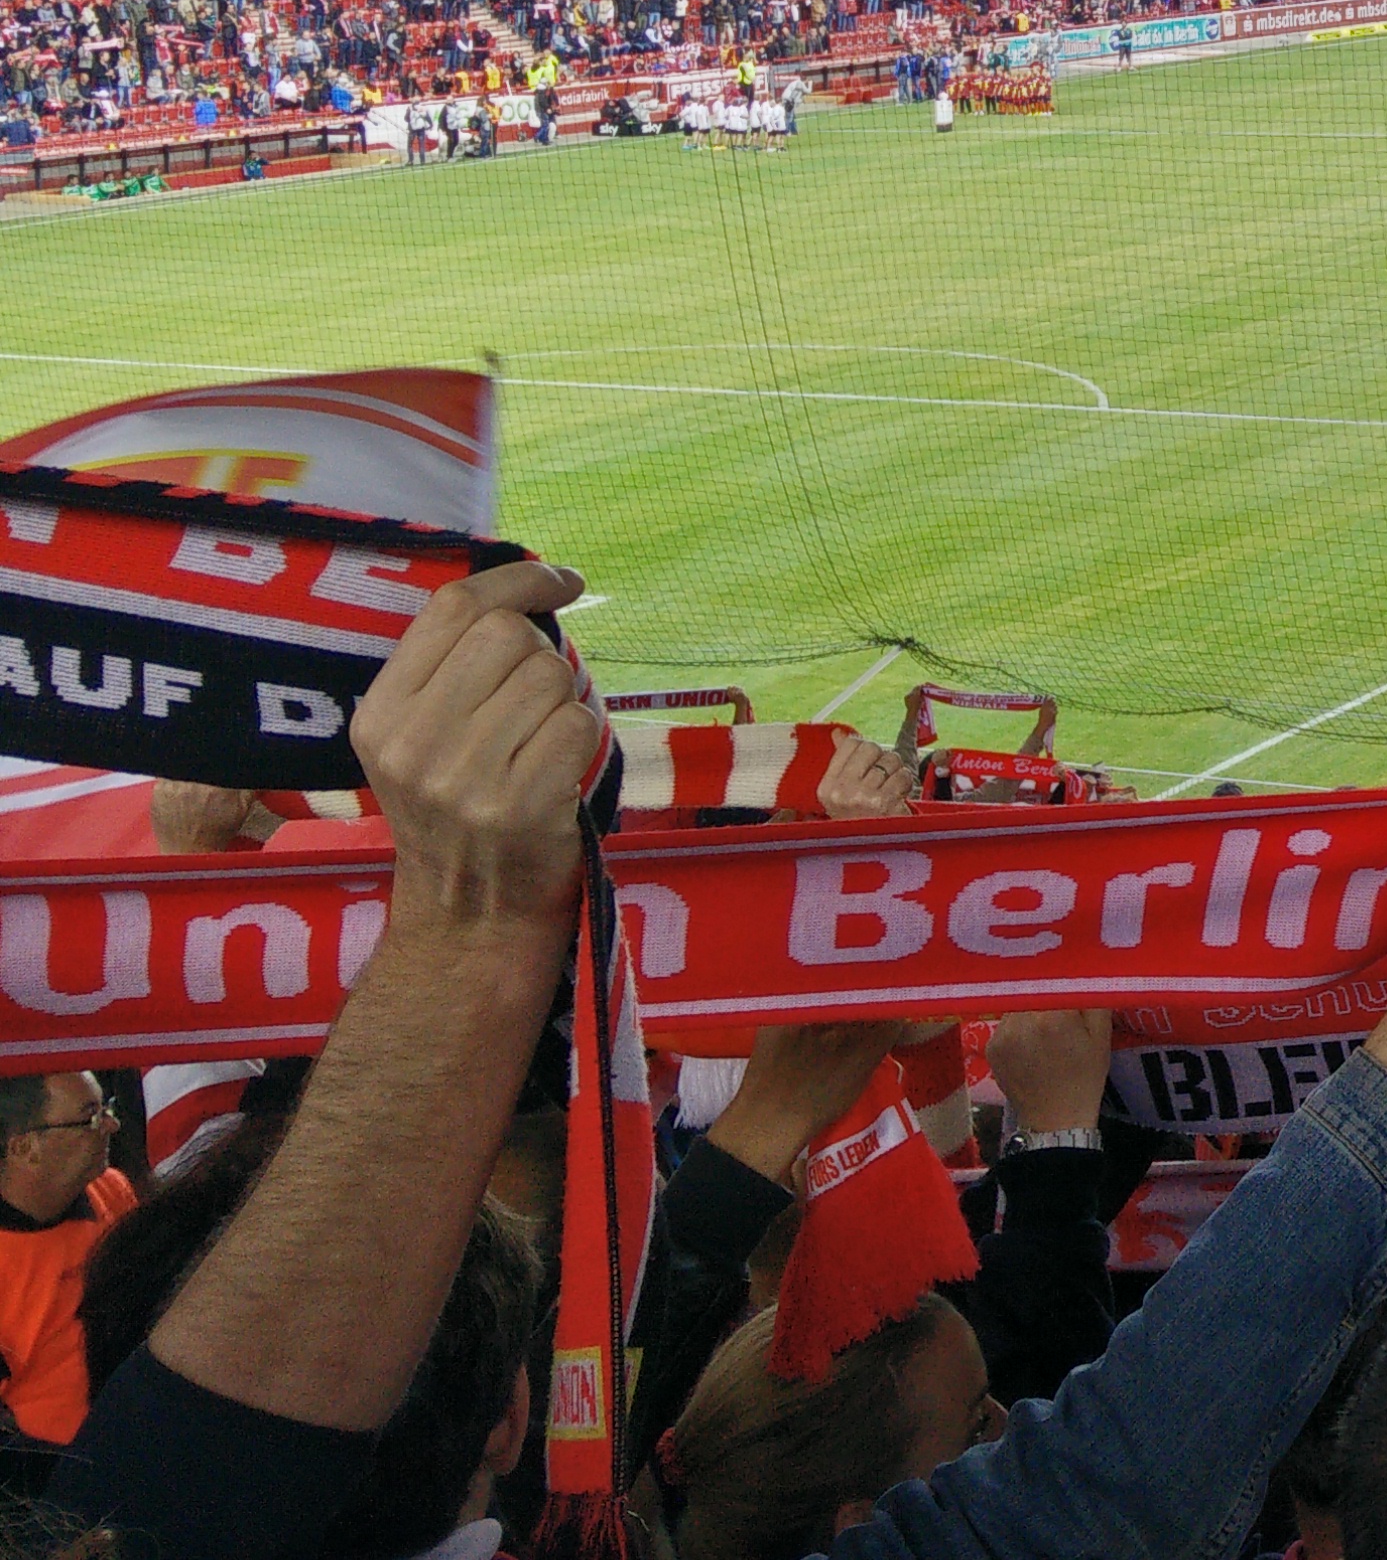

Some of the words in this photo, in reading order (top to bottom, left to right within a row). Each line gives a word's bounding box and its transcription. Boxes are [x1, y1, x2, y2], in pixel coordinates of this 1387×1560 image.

[599, 122, 619, 136] sky
[642, 121, 663, 134] sky
[169, 524, 432, 617] BE
[0, 635, 203, 720] AUF
[606, 695, 652, 711] ERN
[666, 690, 728, 707] UNIO
[0, 880, 689, 1017] Unin
[807, 1155, 840, 1193] FÜRS
[838, 1129, 882, 1170] LEBEN
